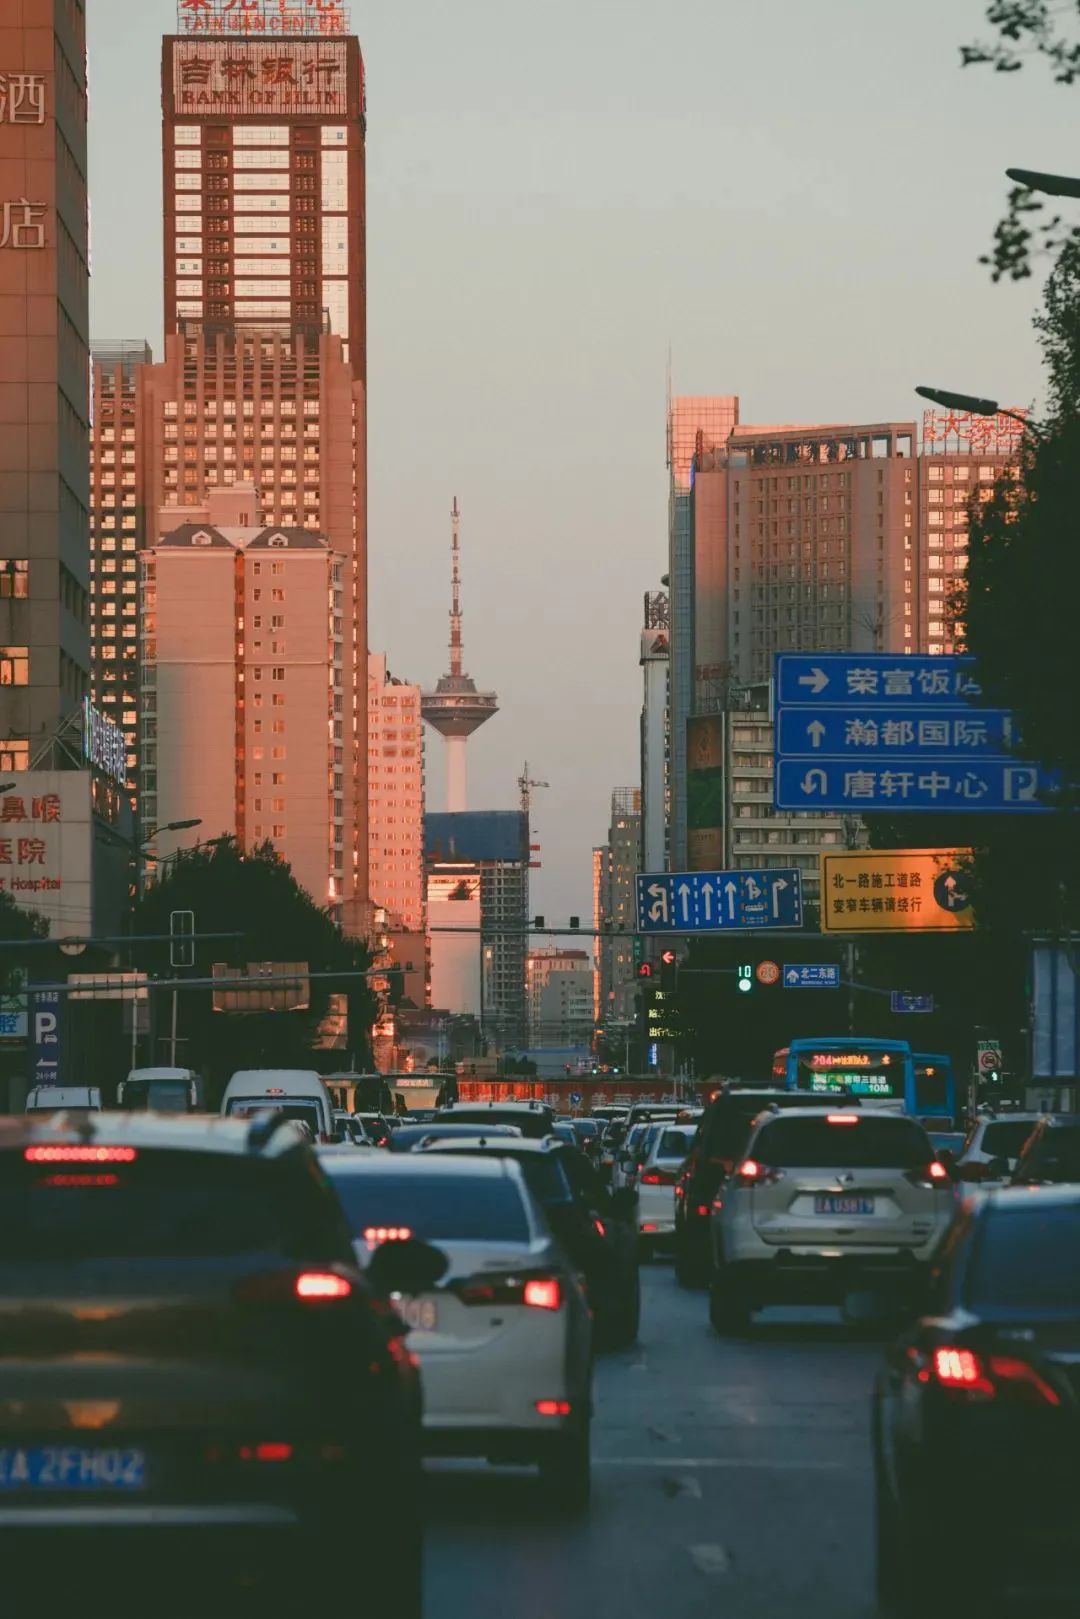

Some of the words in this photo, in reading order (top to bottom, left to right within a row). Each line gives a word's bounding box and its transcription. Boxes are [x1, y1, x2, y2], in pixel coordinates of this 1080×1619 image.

[179, 55, 341, 84] 吉林银行
[182, 91, 241, 105] BANK
[844, 719, 988, 747] 瀚都国际
[843, 771, 989, 799] 唐轩中心
[11, 875, 62, 894] Hospital
[833, 872, 922, 888] 北一路施工道路
[833, 897, 922, 913] 变窄车辆请绕行
[738, 965, 752, 978] 10
[801, 967, 836, 979] 北二东路
